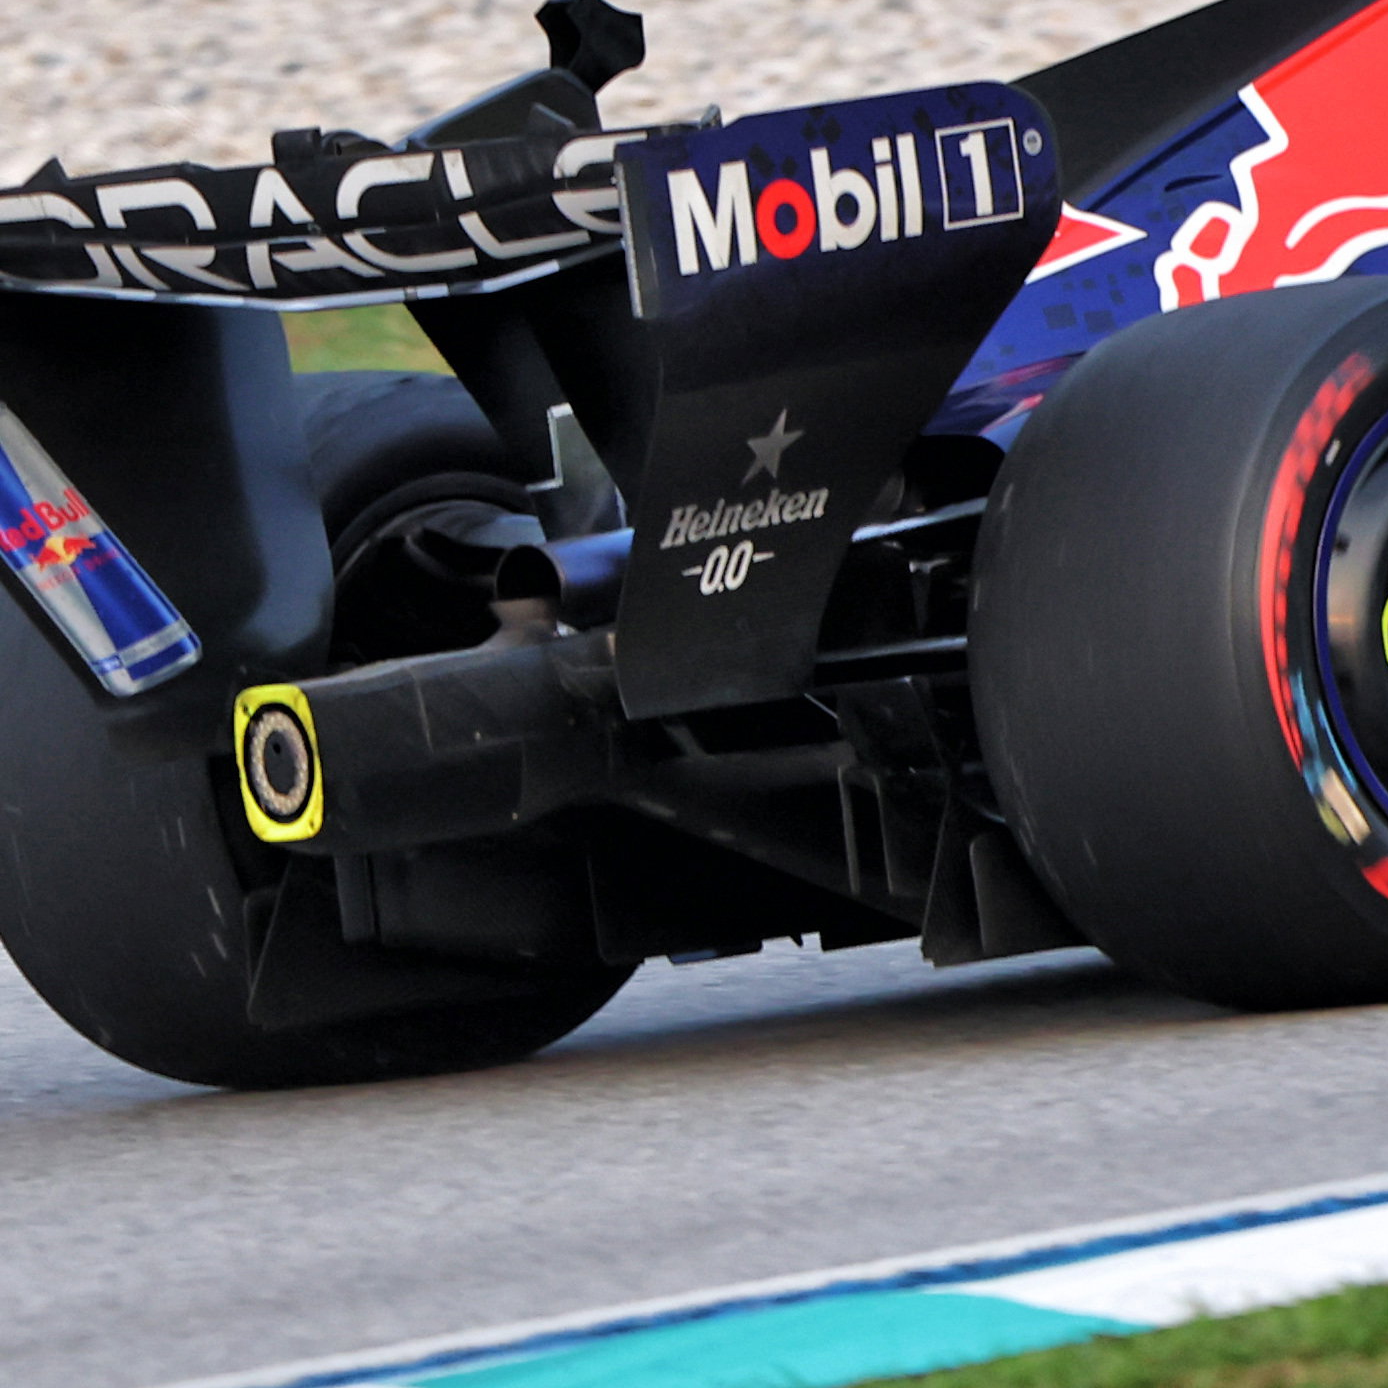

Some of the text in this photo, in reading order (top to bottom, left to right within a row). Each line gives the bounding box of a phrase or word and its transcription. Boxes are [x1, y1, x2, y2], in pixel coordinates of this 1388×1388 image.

[667, 133, 923, 276] Mobil
[33, 488, 90, 531] Bull
[659, 487, 829, 550] Heineken
